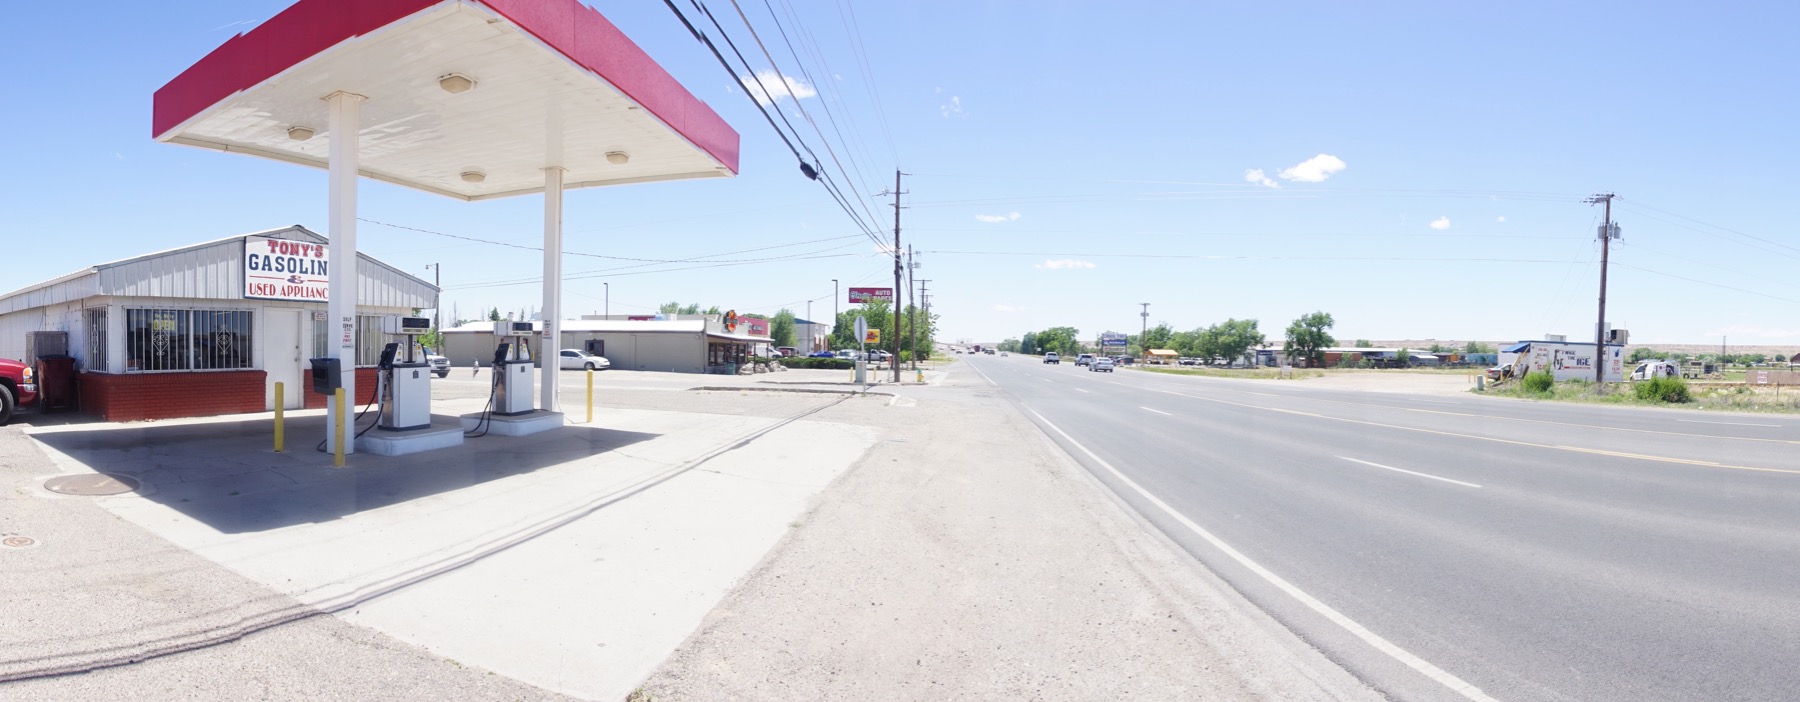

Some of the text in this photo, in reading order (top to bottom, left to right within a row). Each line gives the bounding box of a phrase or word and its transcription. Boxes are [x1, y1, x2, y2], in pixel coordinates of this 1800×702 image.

[268, 239, 324, 258] TONY'S
[248, 253, 328, 276] GASOLIN
[249, 282, 329, 299] USED APPLIANC
